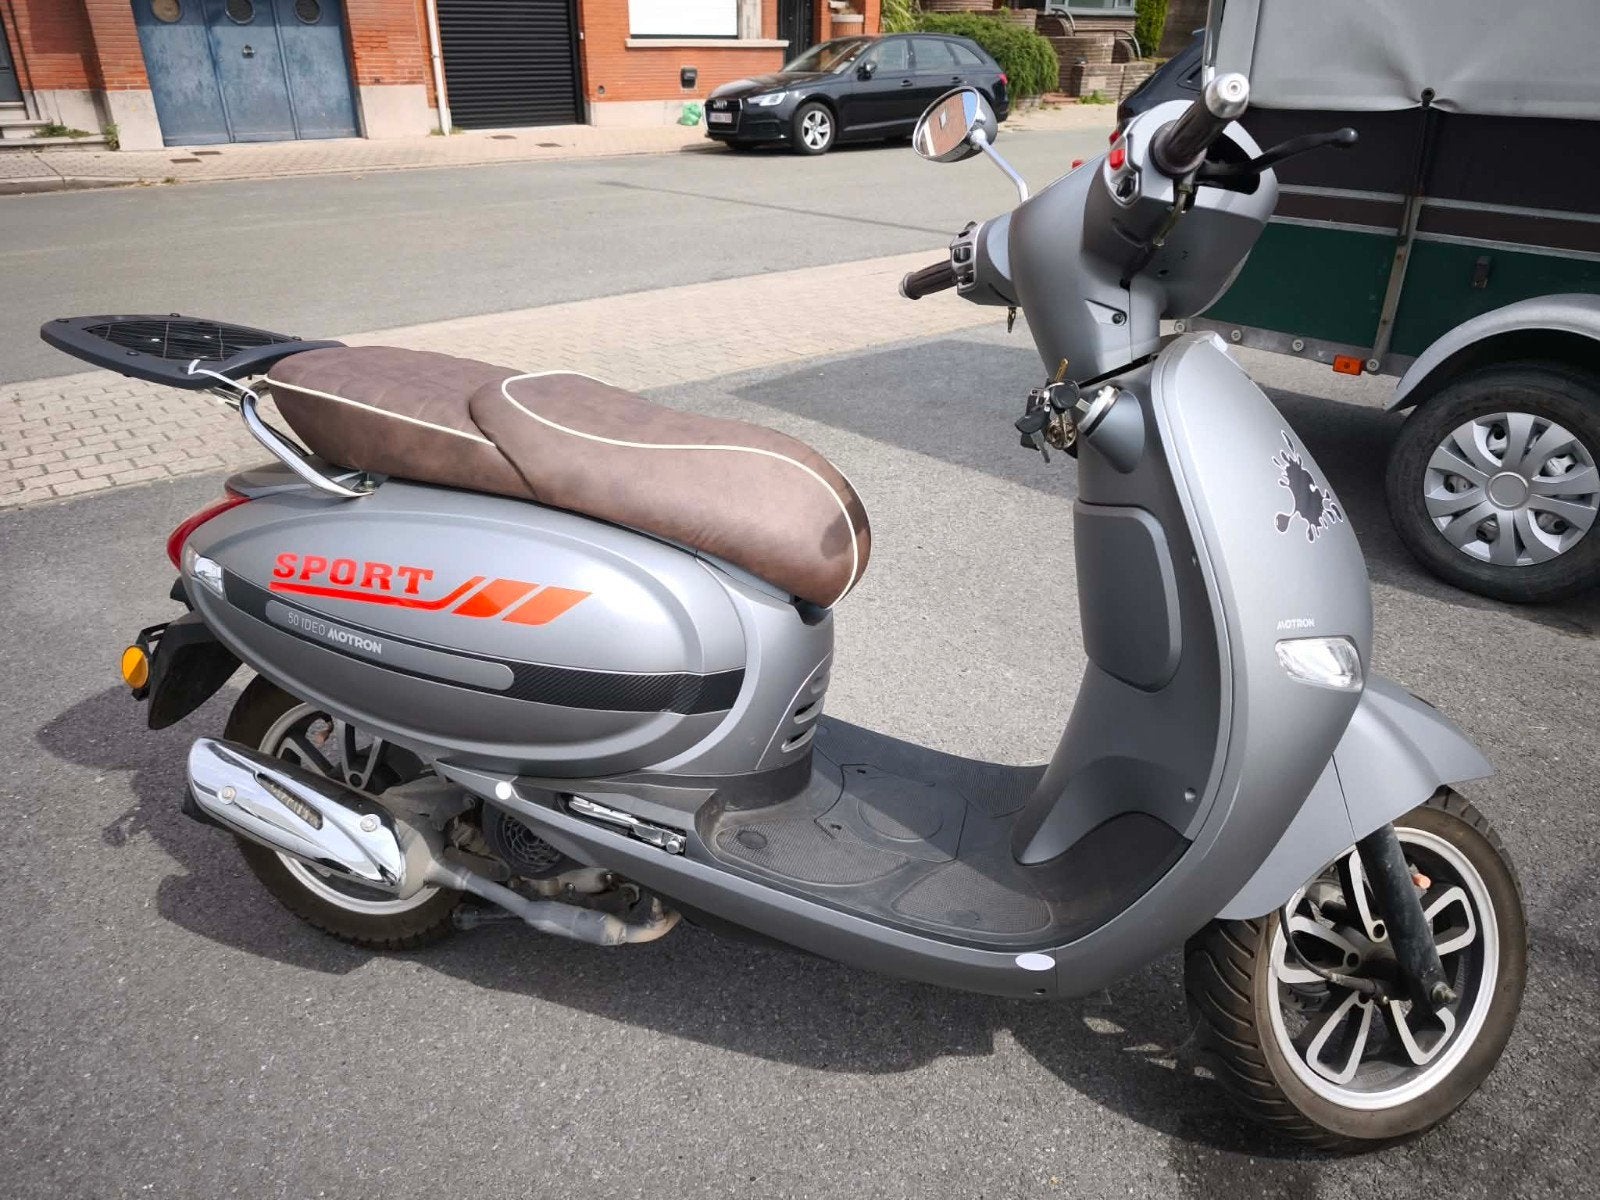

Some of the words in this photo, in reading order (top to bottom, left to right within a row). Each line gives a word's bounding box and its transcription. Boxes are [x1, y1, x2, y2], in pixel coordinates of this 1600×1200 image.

[273, 552, 434, 595] SPORT
[288, 611, 299, 626] 50
[327, 627, 382, 654] MOTRON
[1276, 618, 1316, 630] MOTRON
